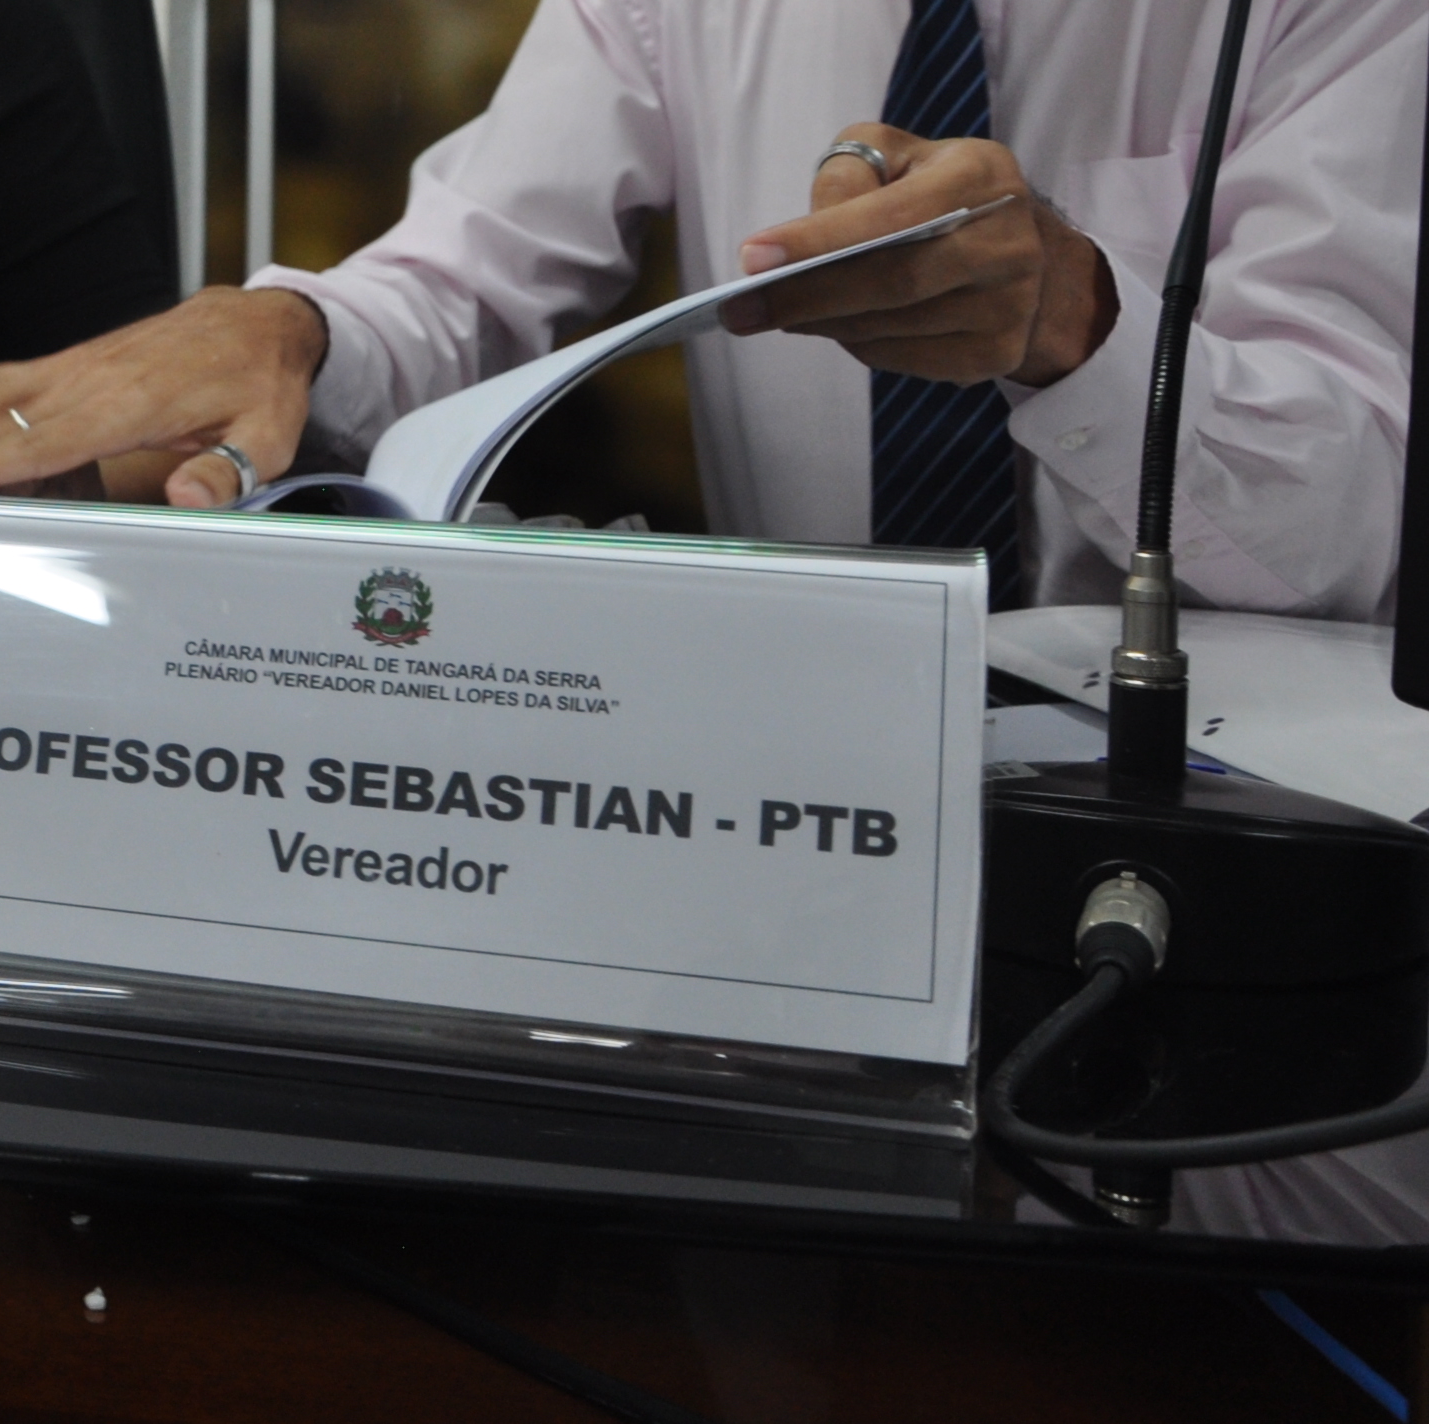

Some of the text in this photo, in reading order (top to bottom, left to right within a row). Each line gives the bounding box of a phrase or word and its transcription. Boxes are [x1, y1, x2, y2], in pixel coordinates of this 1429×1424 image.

[164, 662, 258, 684] PLENÁRIO
[380, 681, 450, 701] DANIEL
[455, 687, 519, 707] LOPES
[525, 693, 552, 710] DA
[184, 639, 602, 690] CÂMARA MUNICIPAL DE TANGARÁ DA SERRA
[306, 757, 694, 842] SEBASTIAN
[758, 799, 900, 860] PTB
[268, 829, 510, 898] Vereador
